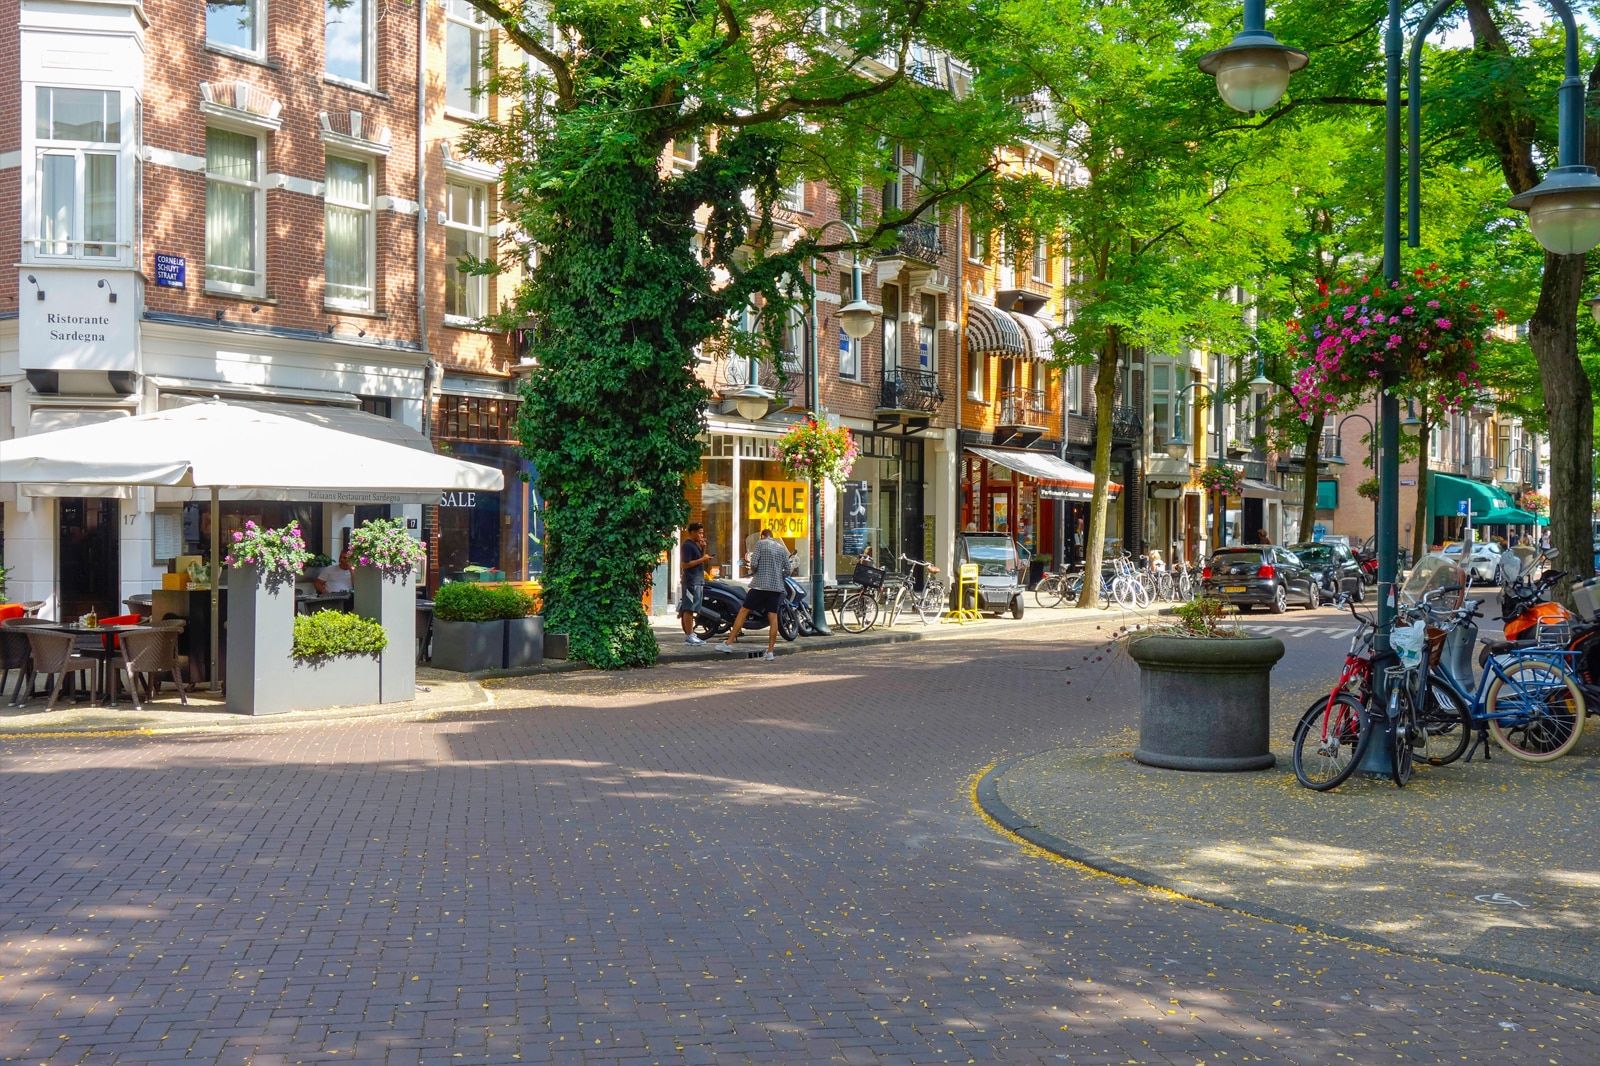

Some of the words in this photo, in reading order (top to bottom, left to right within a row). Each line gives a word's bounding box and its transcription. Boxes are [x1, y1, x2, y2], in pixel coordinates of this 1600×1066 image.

[157, 263, 179, 273] SCHUYT
[158, 271, 178, 281] STRAAT
[47, 313, 110, 325] Ristorante
[50, 330, 105, 343] Sardegna
[338, 492, 371, 501] Restaurant
[372, 493, 401, 503] Sardegna
[440, 491, 476, 508] SALE
[753, 486, 804, 513] SALE
[123, 514, 137, 526] 17
[768, 518, 787, 533] 50%
[788, 518, 804, 533] Off
